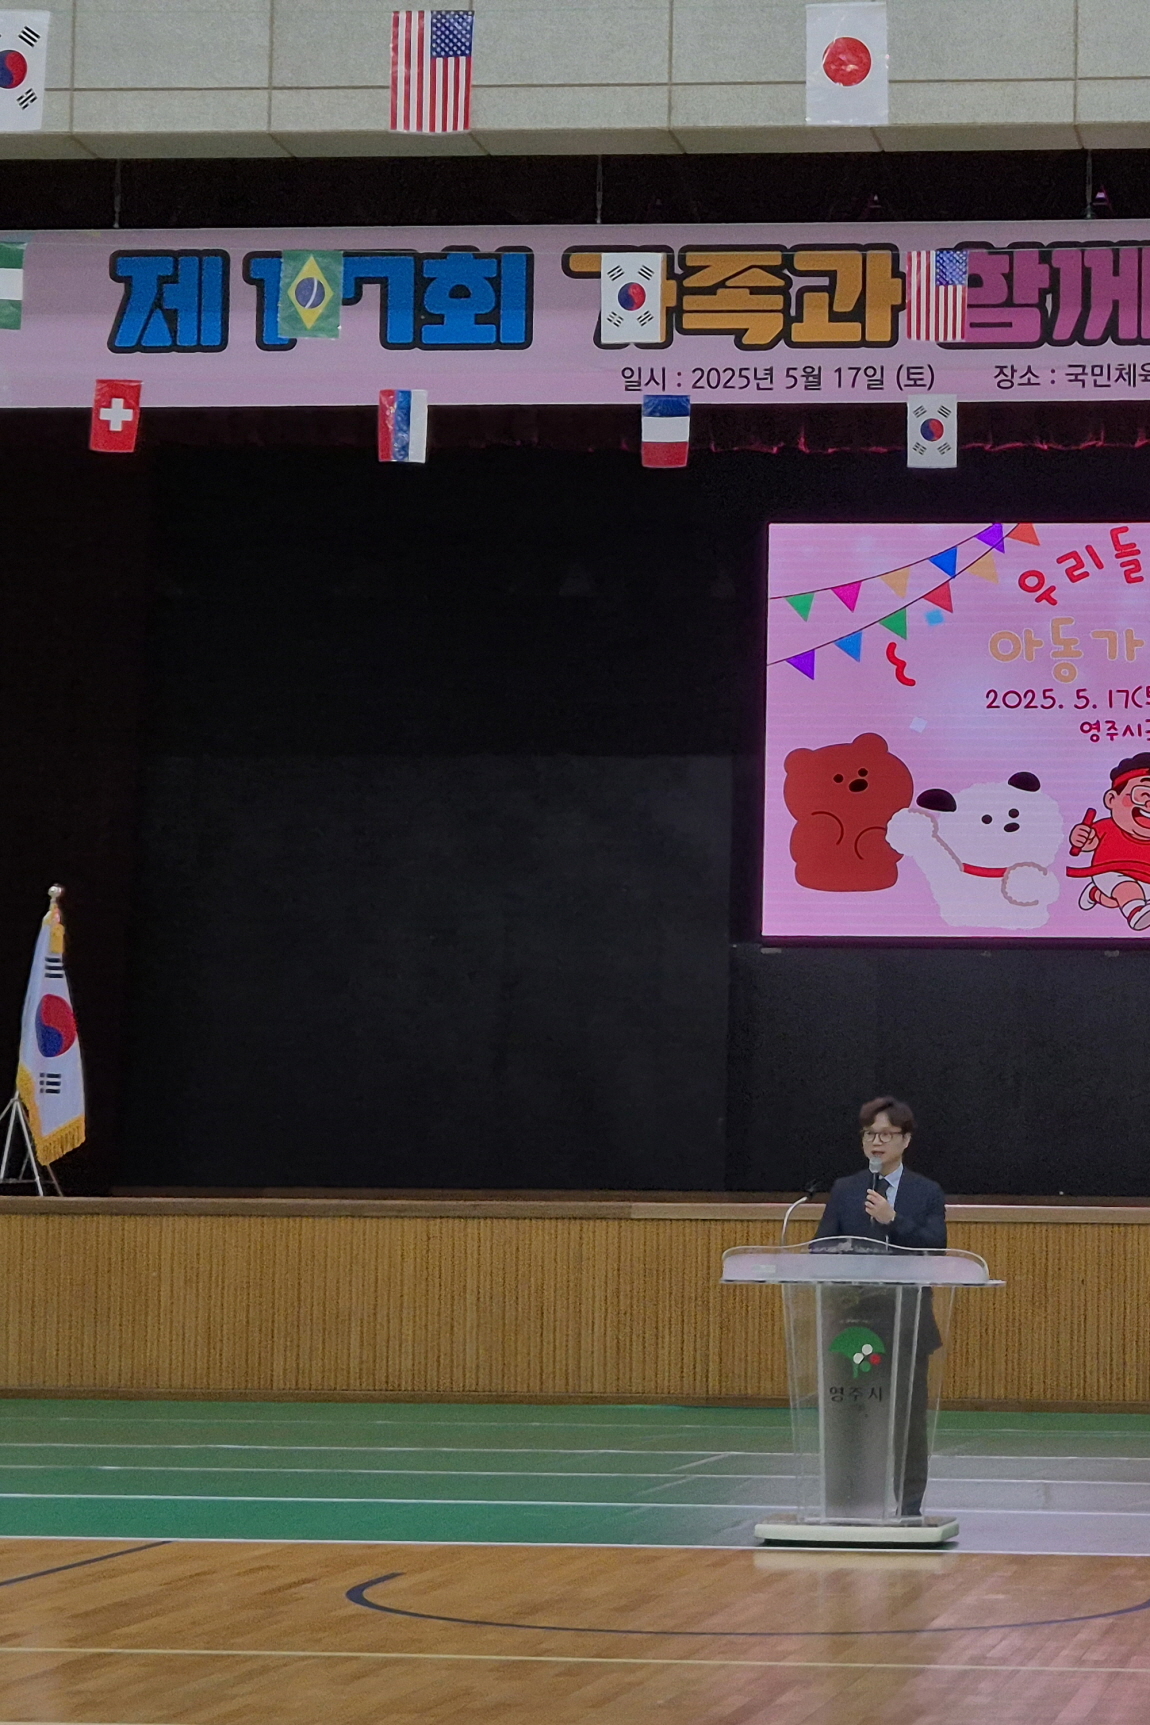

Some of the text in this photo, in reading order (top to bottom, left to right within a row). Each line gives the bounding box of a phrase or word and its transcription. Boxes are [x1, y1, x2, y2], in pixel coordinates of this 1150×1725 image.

[621, 365, 667, 392] 일시
[690, 365, 775, 391] 2025년
[784, 365, 823, 392] 5월
[833, 365, 885, 390] 17일
[895, 364, 936, 391] (토)
[993, 364, 1042, 390] 장소
[985, 688, 1064, 710] 2025.
[1073, 687, 1099, 711] 5.
[828, 1386, 883, 1402] 영주시
